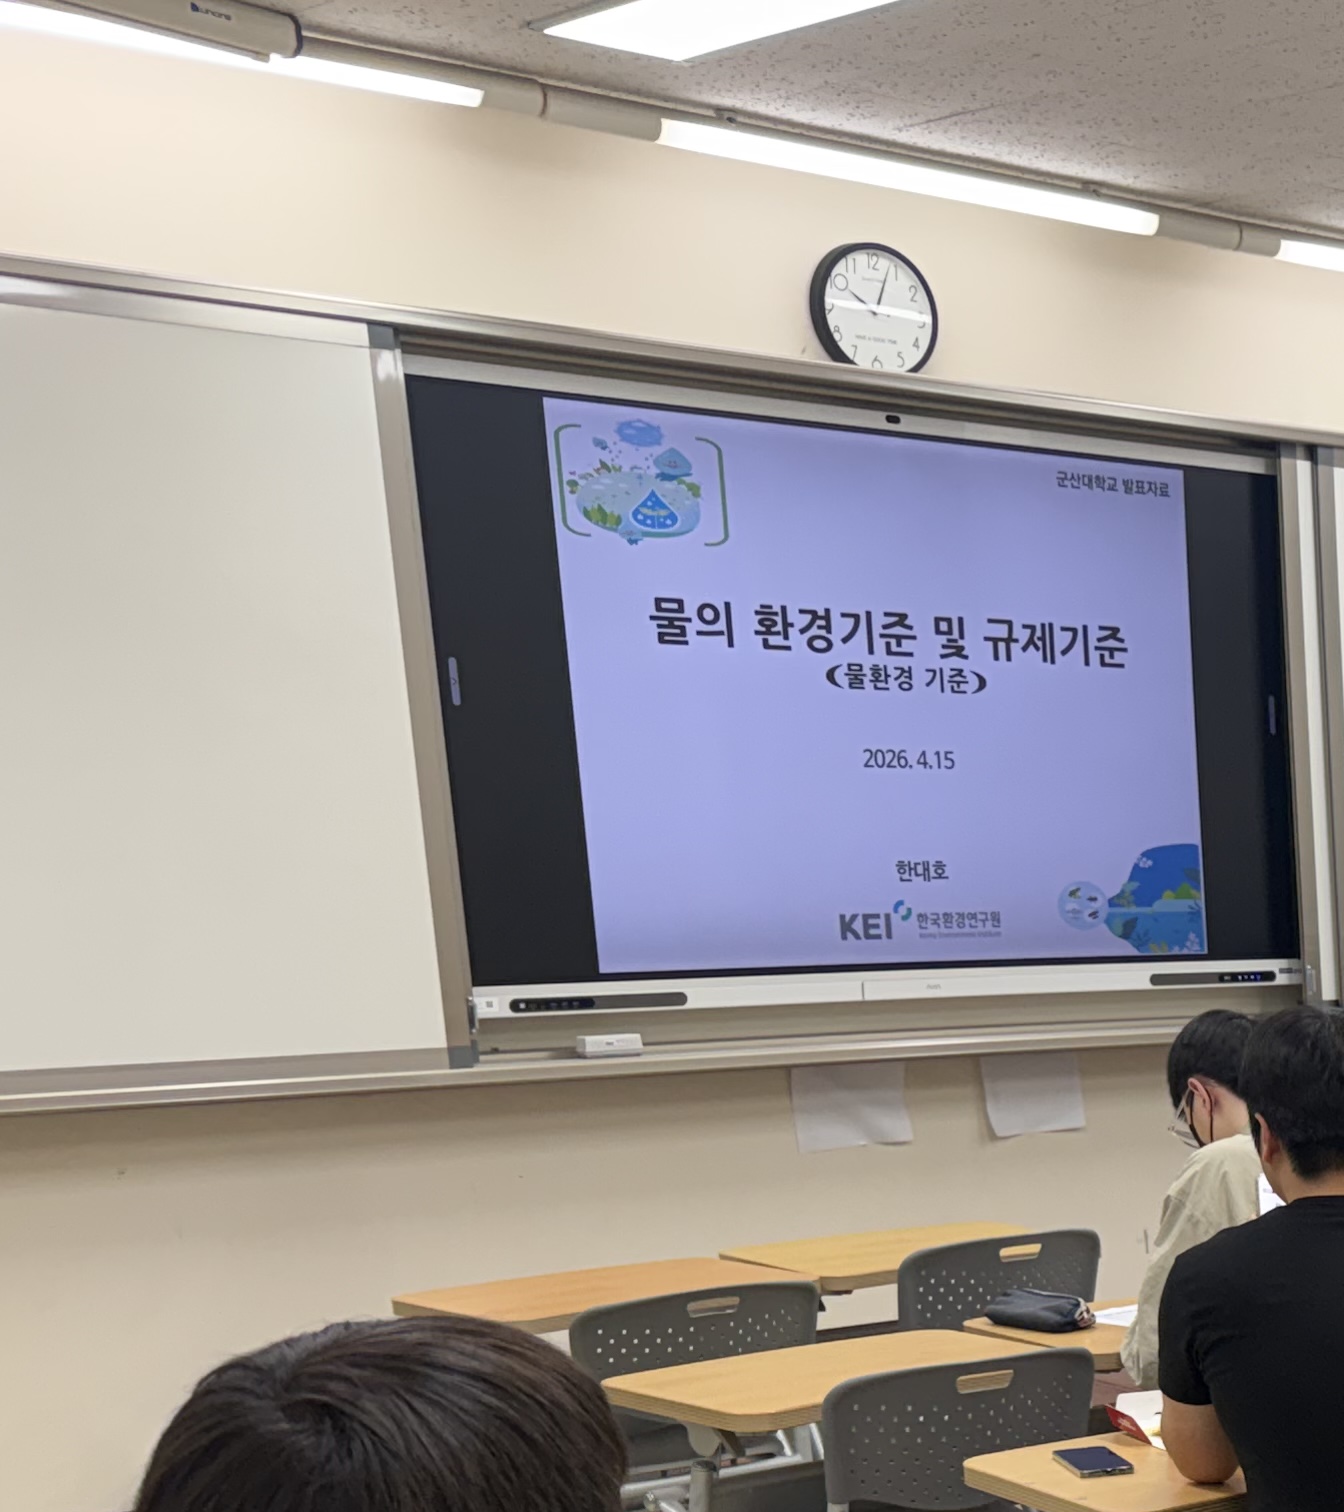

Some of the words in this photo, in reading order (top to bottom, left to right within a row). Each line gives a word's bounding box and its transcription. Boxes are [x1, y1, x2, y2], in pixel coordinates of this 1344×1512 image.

[845, 256, 856, 274] 11
[865, 252, 880, 271] 12
[893, 263, 899, 281] 1
[829, 273, 849, 292] 10
[908, 284, 918, 303] 2
[833, 325, 843, 343] 8
[851, 344, 858, 361] 7
[912, 336, 921, 351] 4
[871, 355, 883, 369] 6
[896, 351, 905, 368] 5
[1056, 470, 1119, 492] 군산대학교
[1122, 478, 1171, 498] 발표자료
[649, 597, 734, 648] 물의
[754, 604, 917, 657] 환경기준
[933, 616, 969, 660] 및
[983, 617, 1129, 669] 규제기준
[825, 663, 914, 692] (물환경
[925, 667, 987, 694] 기준)
[895, 860, 949, 882] 한대호
[839, 913, 893, 941] KEI
[916, 911, 1001, 929] 한국환경연구원
